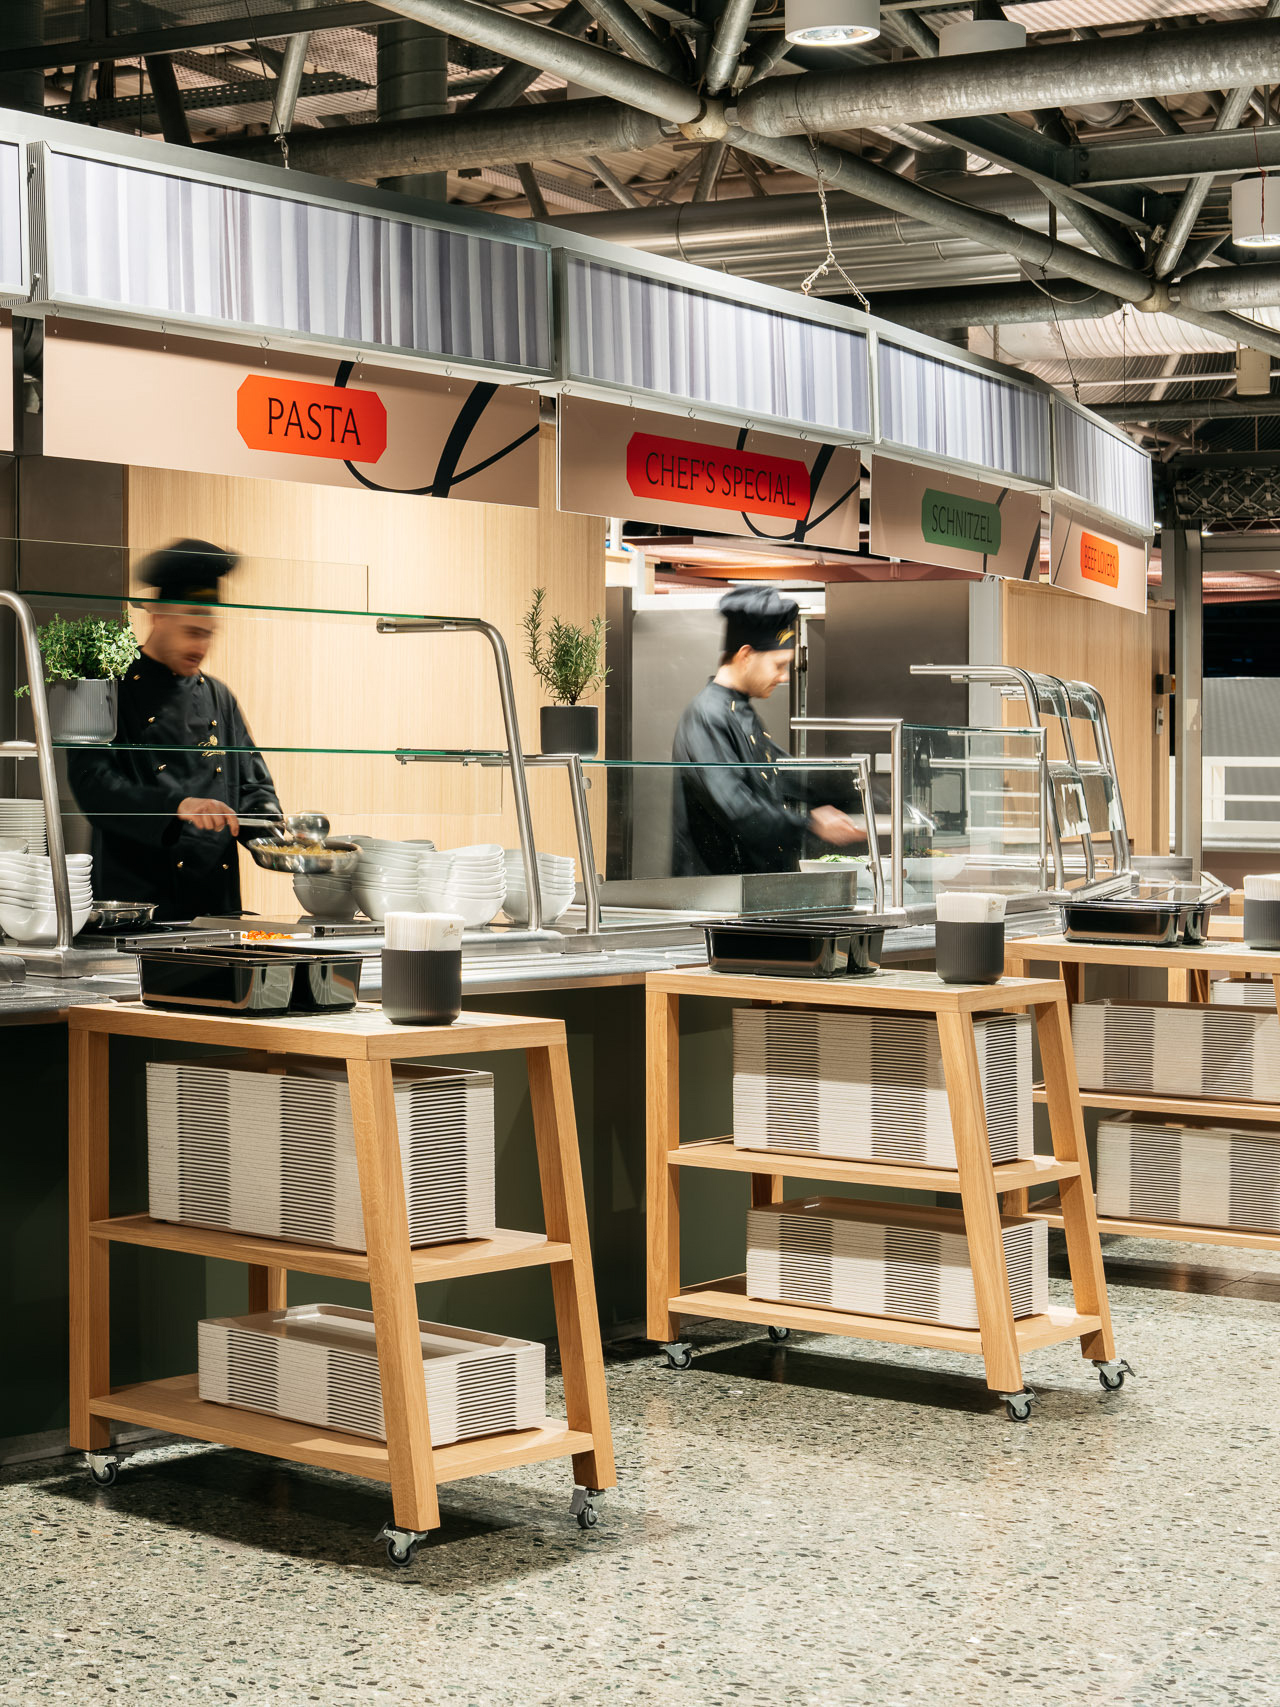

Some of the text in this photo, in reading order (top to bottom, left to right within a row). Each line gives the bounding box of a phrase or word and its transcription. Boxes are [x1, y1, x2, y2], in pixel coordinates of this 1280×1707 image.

[267, 397, 361, 446] PASTA
[645, 451, 796, 506] CHEF'S SPECIAL
[931, 504, 993, 544] SCHNITZEL
[1084, 544, 1097, 572] BEEF
